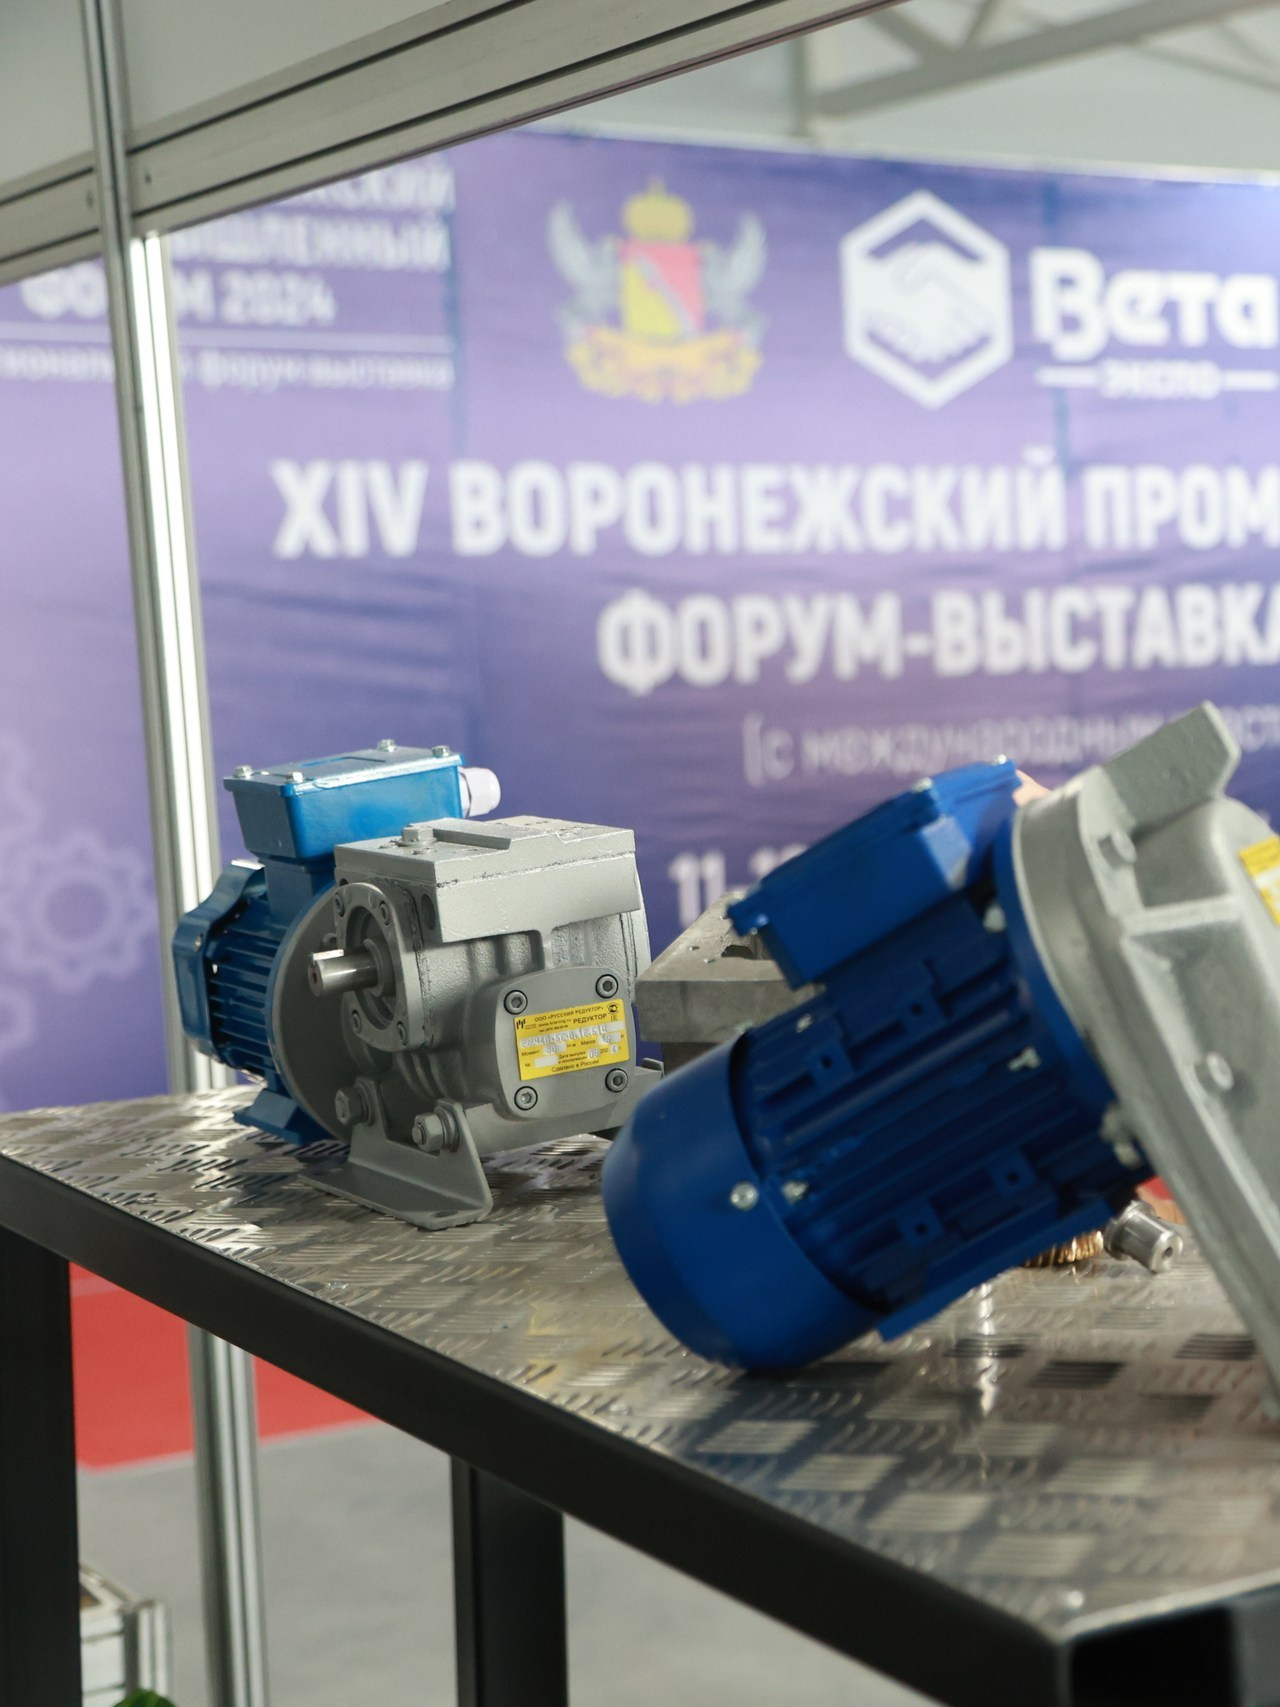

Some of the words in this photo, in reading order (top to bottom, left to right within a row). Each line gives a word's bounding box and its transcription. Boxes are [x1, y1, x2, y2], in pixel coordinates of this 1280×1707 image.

[219, 269, 337, 326] 2024
[270, 457, 430, 560] XIV
[449, 445, 1068, 557] ВОРОНЕЖСКИЙ
[547, 1011, 574, 1020] «РУССКИЙ
[574, 1005, 604, 1015] РЕДУКТОР»
[572, 1013, 608, 1024] РЕДУКТОР
[580, 1038, 596, 1046] Масса
[551, 1063, 575, 1072] Сделано
[579, 1058, 600, 1067] России
